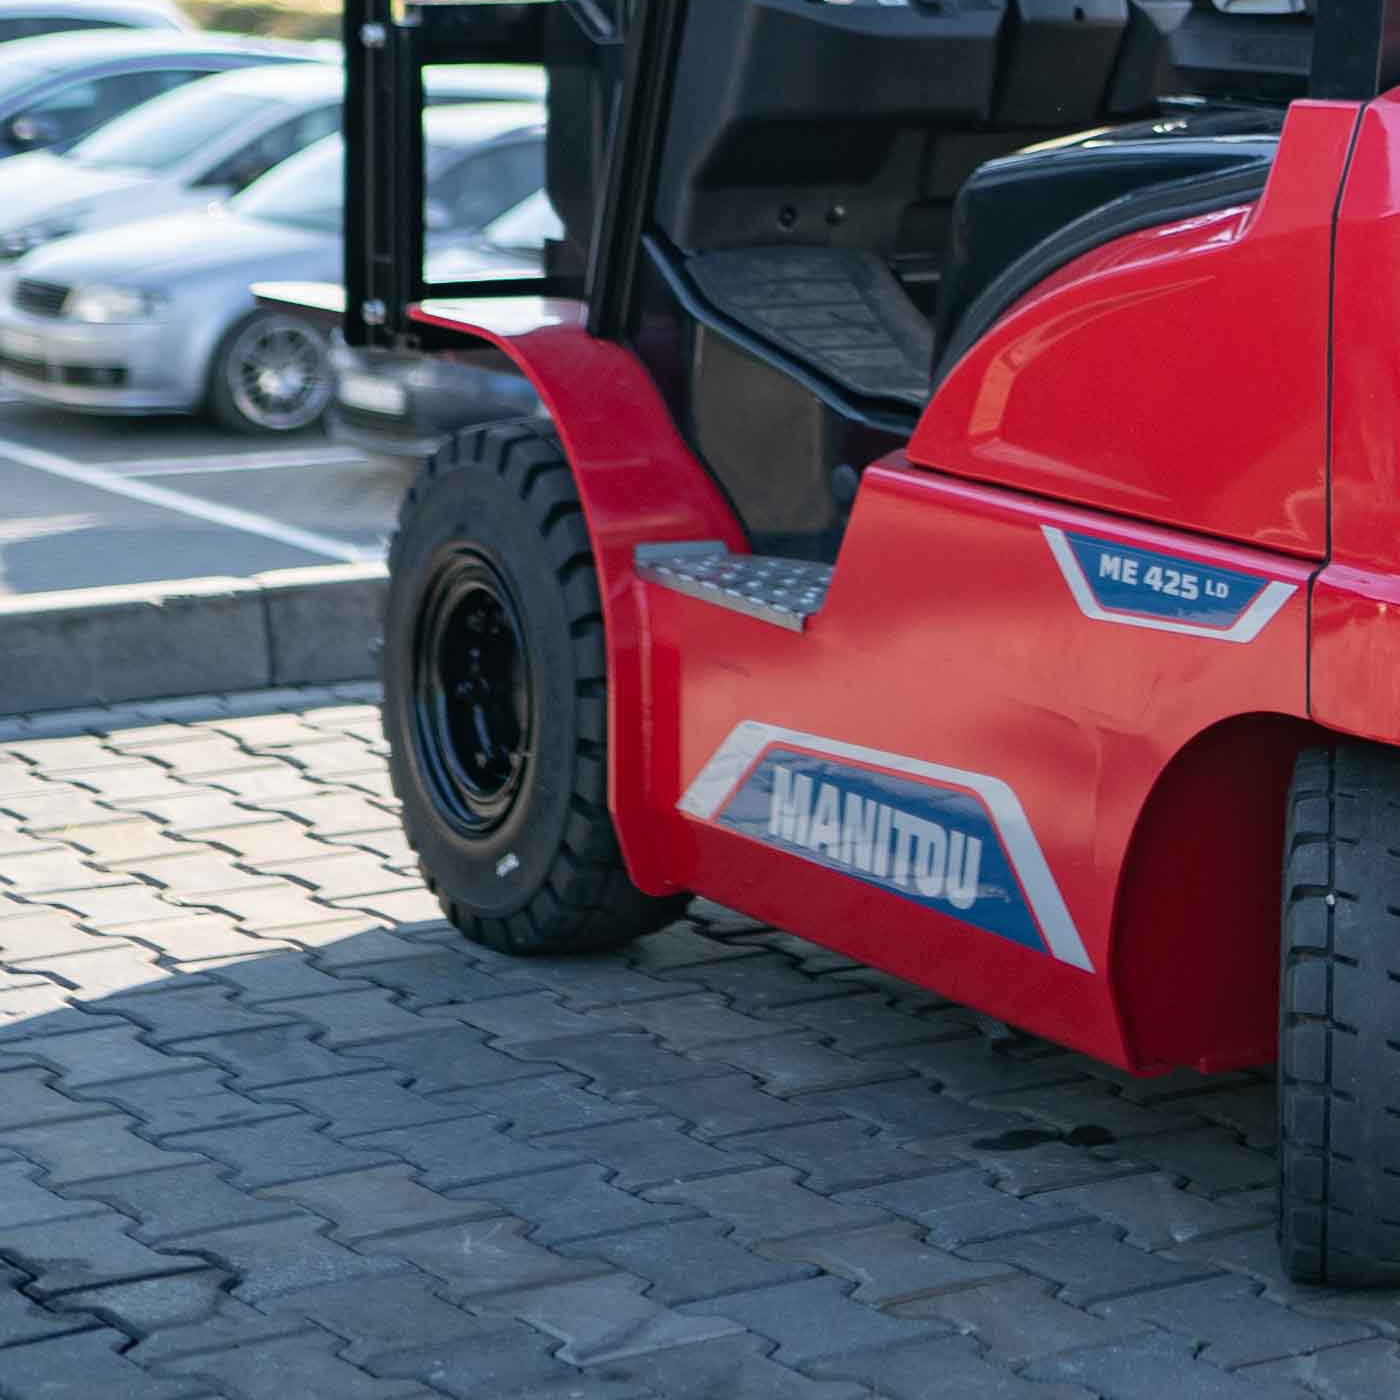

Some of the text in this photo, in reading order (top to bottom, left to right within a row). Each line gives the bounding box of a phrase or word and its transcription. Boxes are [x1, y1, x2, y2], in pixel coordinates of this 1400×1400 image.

[1099, 552, 1230, 601] ME 425 LD
[768, 764, 983, 910] MANITOU
